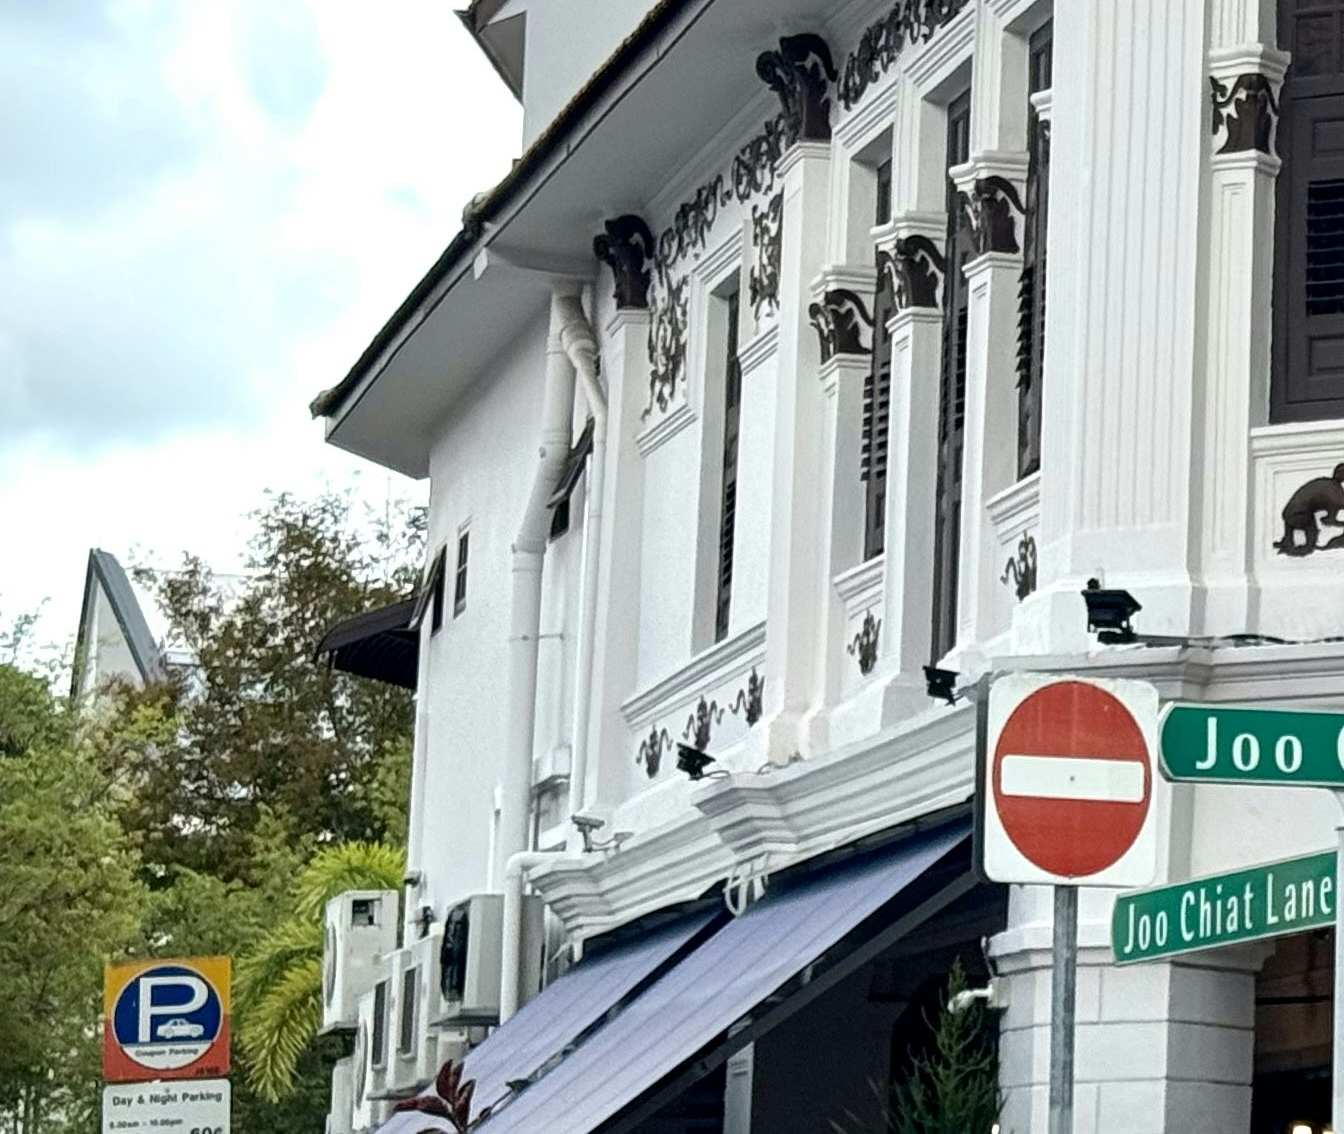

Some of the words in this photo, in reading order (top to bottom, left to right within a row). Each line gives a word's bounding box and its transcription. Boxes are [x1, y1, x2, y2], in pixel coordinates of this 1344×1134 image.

[1195, 717, 1303, 773] Joo
[1123, 903, 1168, 954] Joo
[1180, 881, 1254, 941] Chiat
[1266, 873, 1333, 925] Lane
[138, 976, 209, 1043] P
[169, 1047, 199, 1057] Parking
[112, 1095, 134, 1107] Day
[137, 1094, 145, 1105] &
[149, 1093, 178, 1106] Night
[182, 1091, 223, 1103] Parking
